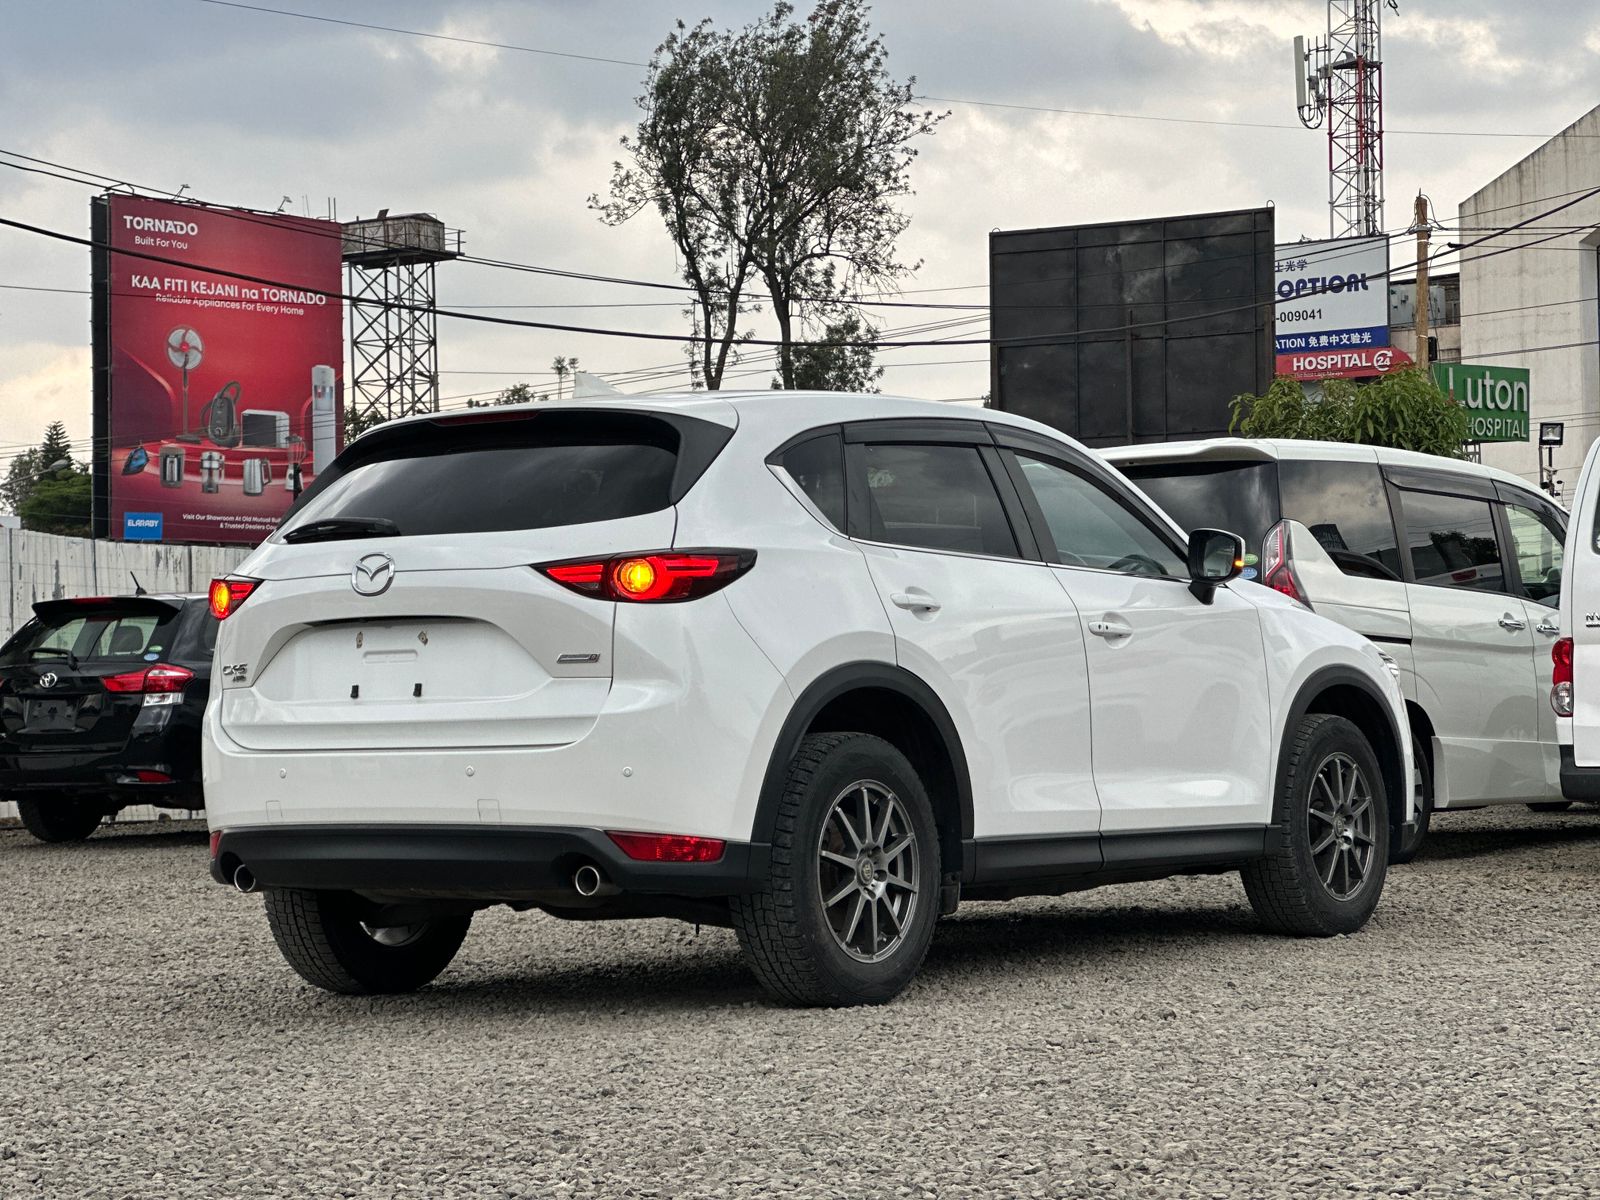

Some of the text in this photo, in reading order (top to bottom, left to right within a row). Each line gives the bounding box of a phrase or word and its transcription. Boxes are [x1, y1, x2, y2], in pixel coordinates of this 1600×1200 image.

[123, 215, 198, 236] TORNADO
[134, 235, 188, 249] Built For You
[131, 275, 326, 305] KAA FITI KEJANI na TORNADO
[155, 293, 304, 316] Reliable Appliances For Every Home
[1308, 332, 1372, 348] 免费中文验光
[1293, 353, 1391, 371] HOSPITAL 24
[1466, 416, 1527, 438] HOSPITAL
